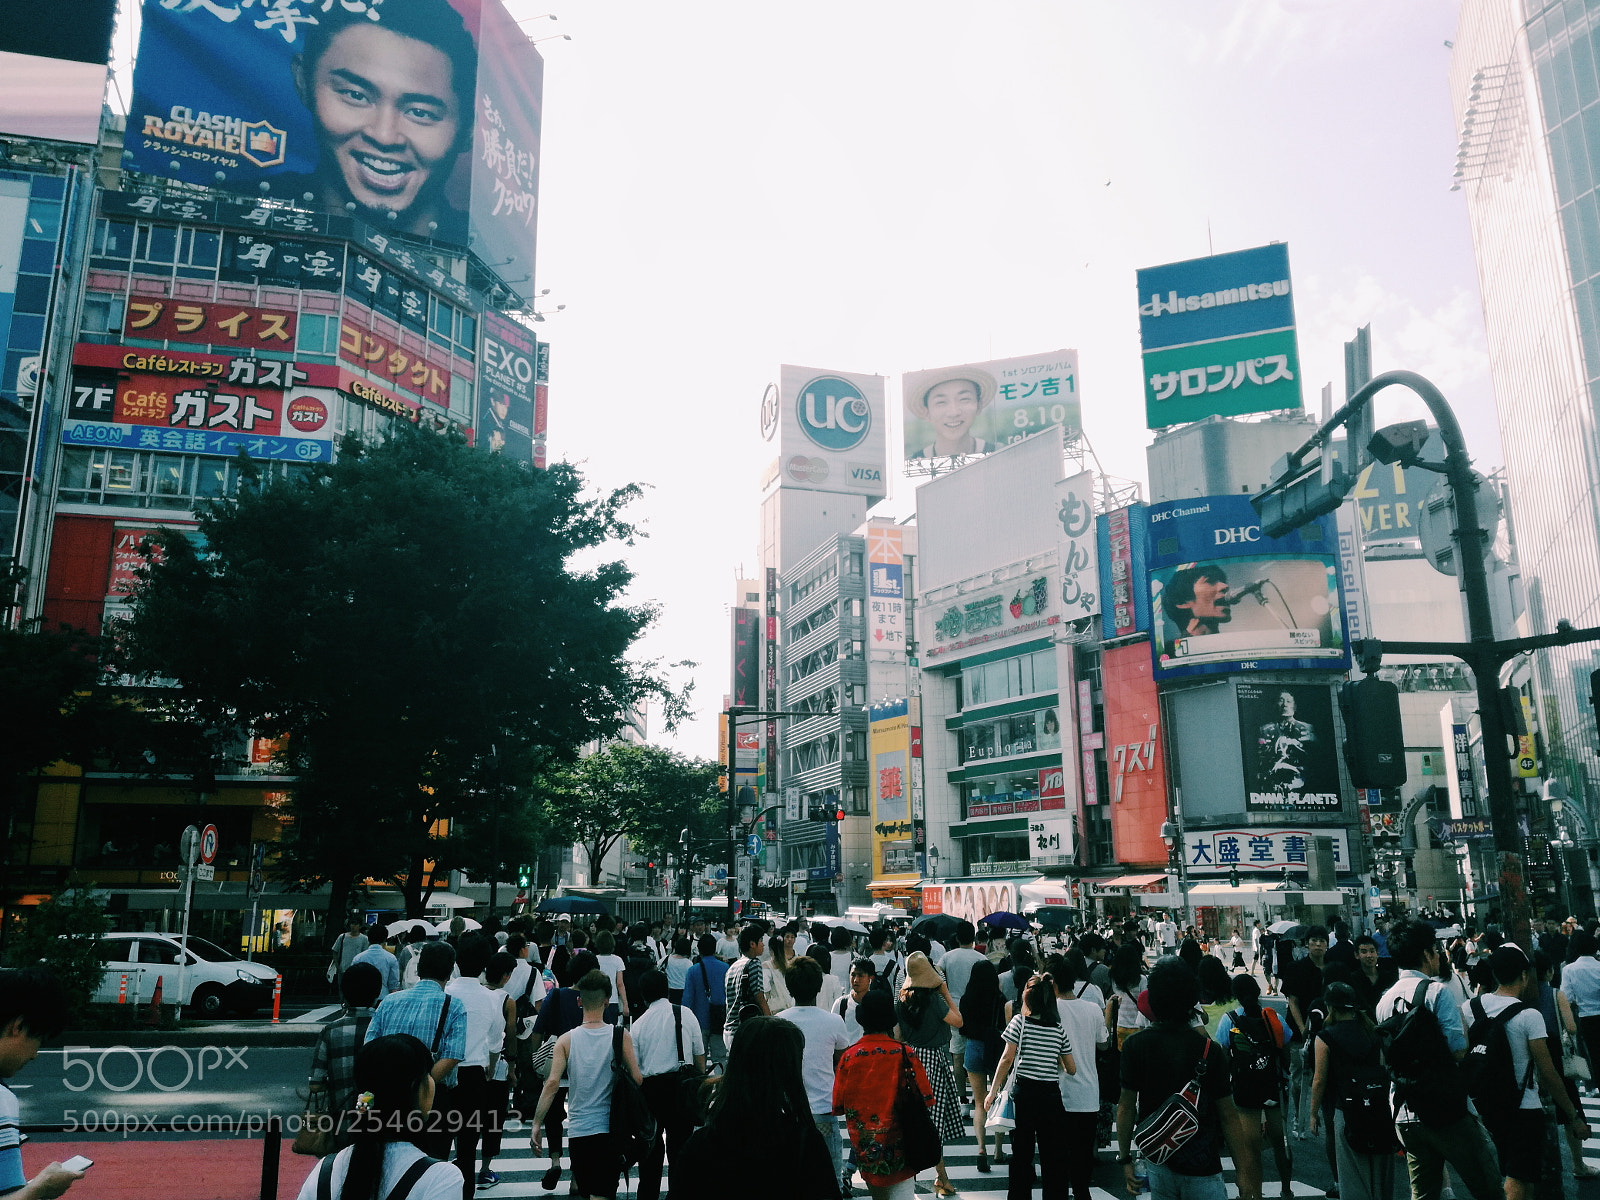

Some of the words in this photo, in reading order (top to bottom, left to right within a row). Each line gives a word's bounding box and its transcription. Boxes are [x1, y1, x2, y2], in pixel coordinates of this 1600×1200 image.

[170, 105, 242, 135] CLASH
[142, 115, 242, 154] ROYALE
[238, 235, 254, 244] 9F
[1139, 279, 1289, 317] Hisamitsu
[129, 302, 291, 342] プライス
[340, 325, 447, 394] コンタクト
[484, 337, 532, 383] EXO
[1002, 368, 1018, 377] 1st
[1020, 362, 1072, 376] ソロアルバム
[229, 358, 308, 388] ガスト
[485, 366, 516, 388] PLANET
[517, 381, 527, 395] #3
[1150, 354, 1294, 401] サロンパス
[74, 386, 114, 409] 7F
[123, 390, 168, 409] Café
[999, 373, 1075, 401] モン吉1
[123, 407, 167, 420] レストラン
[170, 390, 273, 430] ガスト
[291, 411, 325, 424] ガスト
[1014, 404, 1066, 428] 8.10
[72, 424, 123, 442] AEON
[140, 429, 288, 456] 英会話イーオン
[299, 442, 319, 459] 6F
[789, 463, 829, 475] MasterCard
[851, 468, 882, 482] VISA
[1151, 511, 1172, 523] DHC
[1172, 504, 1210, 519] Channel
[1214, 525, 1260, 545] DHC
[1058, 491, 1095, 613] もんじゃ
[1338, 524, 1360, 593] Taisei
[1109, 512, 1130, 628] 三千里薬品
[872, 601, 902, 613] 夜11時
[878, 614, 896, 625] まで
[885, 630, 903, 642] 地下
[1241, 661, 1258, 669] DHC
[1113, 723, 1158, 803] クスリ
[1455, 733, 1476, 817] 洋服の青山
[1521, 758, 1533, 769] 4F
[880, 767, 902, 799] 薬
[1041, 771, 1063, 793] JTB
